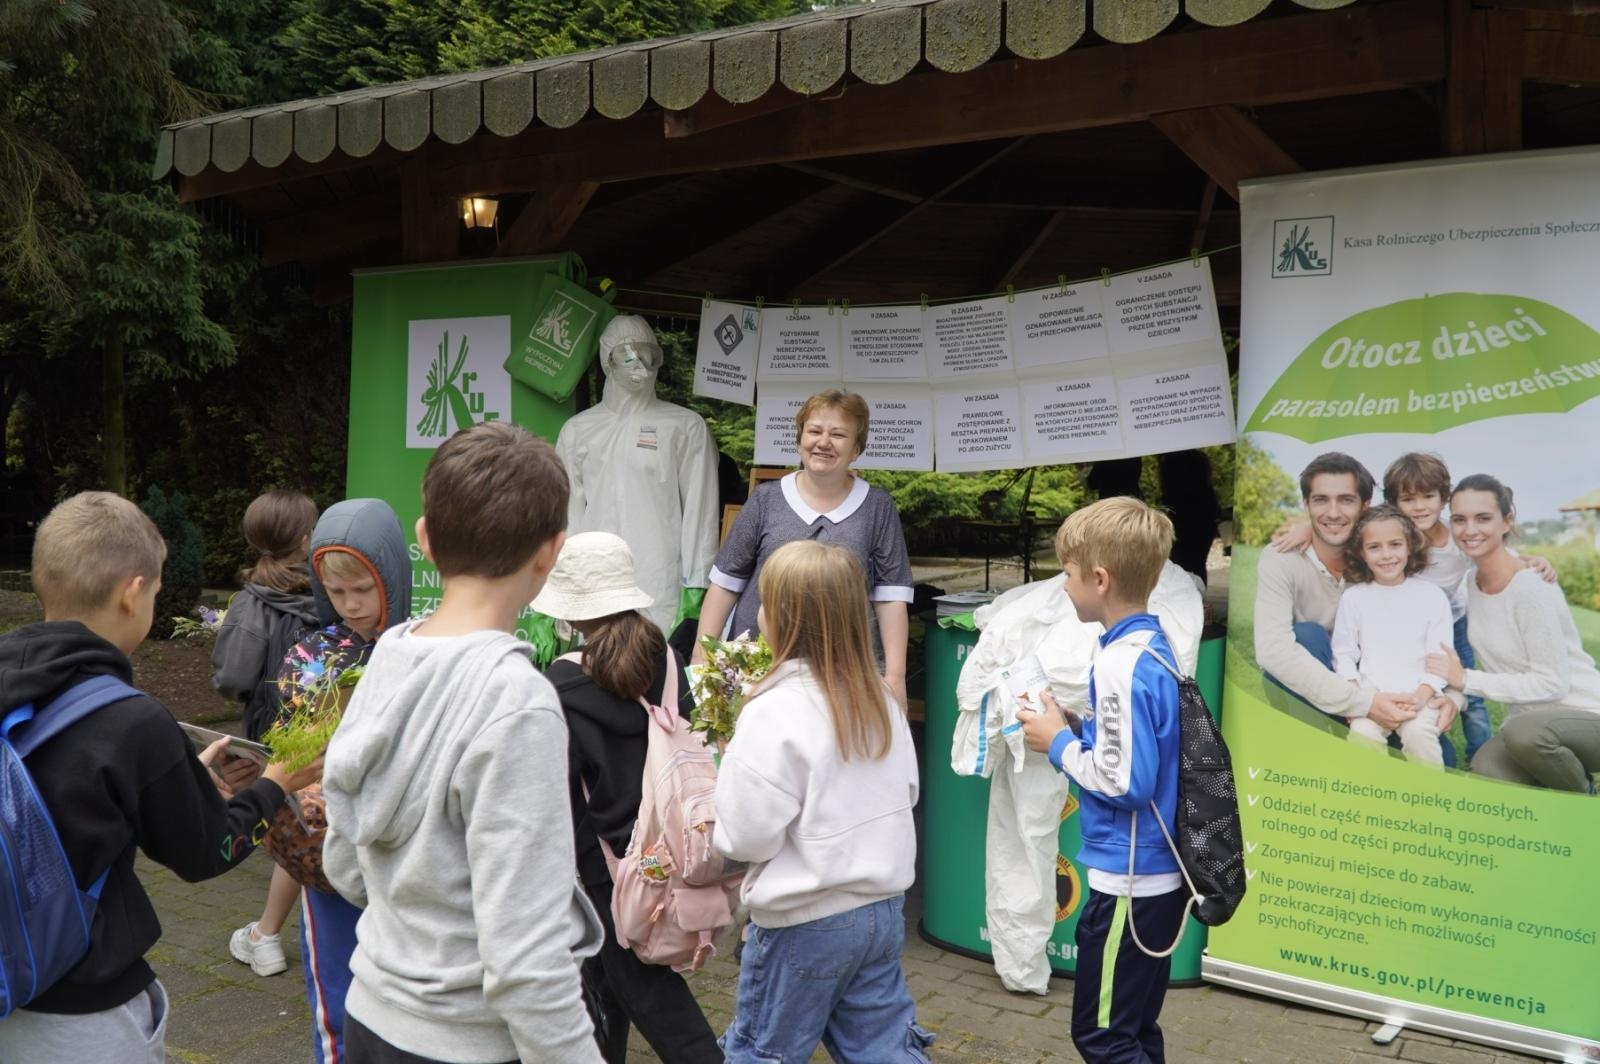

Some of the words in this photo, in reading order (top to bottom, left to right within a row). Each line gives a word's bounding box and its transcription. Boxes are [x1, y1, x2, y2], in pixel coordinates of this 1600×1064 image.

[1343, 236, 1372, 249] Kasa
[1376, 231, 1445, 247] Rolniczego
[1448, 224, 1541, 242] Ubezpieczenia
[1545, 220, 1600, 236] Społecz
[1143, 272, 1173, 282] ZASADA
[1050, 289, 1077, 300] ZASADA
[1115, 291, 1166, 306] OGRANICZENIE
[1168, 285, 1202, 297] DOSTĘPU
[957, 305, 983, 314] ZASADA
[1122, 307, 1133, 315] DO
[1134, 304, 1153, 312] TYCH
[1154, 295, 1198, 309] SUBSTANCJI
[1039, 306, 1085, 319] ODPOWIEDNIE
[1120, 313, 1151, 324] OSOBOM
[1025, 317, 1073, 330] OZNAKOWANIE
[1074, 312, 1103, 322] MIEJSCA
[1128, 322, 1155, 332] PRZEDE
[1156, 314, 1198, 327] WSZYSTKIM
[1040, 322, 1103, 337] PRZECHOWYWANIA
[1147, 326, 1181, 338] DZIECIOM
[1321, 336, 1422, 369] Otocz
[1431, 307, 1548, 361] dzieci
[1161, 373, 1190, 384] ZASADA
[1064, 382, 1091, 391] ZASADA
[1261, 393, 1399, 423] parasolem
[1407, 357, 1600, 414] bezpieczeństw
[974, 393, 1000, 402] ZASADA
[1129, 392, 1178, 405] POSTĘPOWANIE
[1189, 385, 1221, 396] WYPADEK
[1043, 400, 1089, 410] INFORMOWANIE
[1132, 400, 1188, 413] PRZYPADKOWEGO
[1136, 410, 1169, 421] KONTAKTU
[1170, 407, 1187, 415] ORAZ
[1189, 402, 1221, 412] ZATRUCIA
[962, 410, 1004, 419] PRAWIDŁOWE
[1034, 410, 1077, 419] POSTRONNYCH
[1073, 412, 1119, 423] ZASTOSOWANO
[957, 419, 1005, 428] POSTĘPOWANIE
[1037, 424, 1081, 434] NIEBEZPIECZNE
[1082, 420, 1118, 429] PREPARATY
[979, 427, 1016, 435] PREPARATU
[962, 435, 1008, 445] OPAKOWANIEM
[985, 443, 1012, 451] ZUŻYCIU
[1263, 768, 1328, 793] Zapewnij
[1331, 779, 1397, 801] dzieciom
[1401, 792, 1452, 813] opiekę
[1456, 797, 1539, 822] dorosłych.
[1262, 796, 1316, 817] Oddziel
[1320, 807, 1361, 825] część
[1365, 814, 1452, 843] mieszkalną
[1458, 829, 1572, 857] gospodarstwa
[1261, 818, 1316, 839] rolnego
[1320, 827, 1338, 841] od
[1342, 832, 1388, 850] części
[1392, 842, 1499, 870] produkcyjnej.
[1261, 843, 1335, 872] Zorganizuj
[1339, 860, 1395, 879] miejsce
[1399, 869, 1418, 884] do
[1422, 875, 1475, 894] zabaw.
[1260, 871, 1284, 887] Nie
[1287, 878, 1356, 904] powierzaj
[1360, 890, 1426, 914] dzieciom
[1430, 906, 1513, 931] wykonania
[1517, 921, 1597, 945] czynności
[1259, 893, 1381, 927] przekraczających
[1385, 915, 1407, 931] ich
[1411, 922, 1496, 948] możliwości
[1258, 912, 1369, 945] psychofizyczne.
[1280, 948, 1546, 1015] www.krus.gov.pl/prewencja
